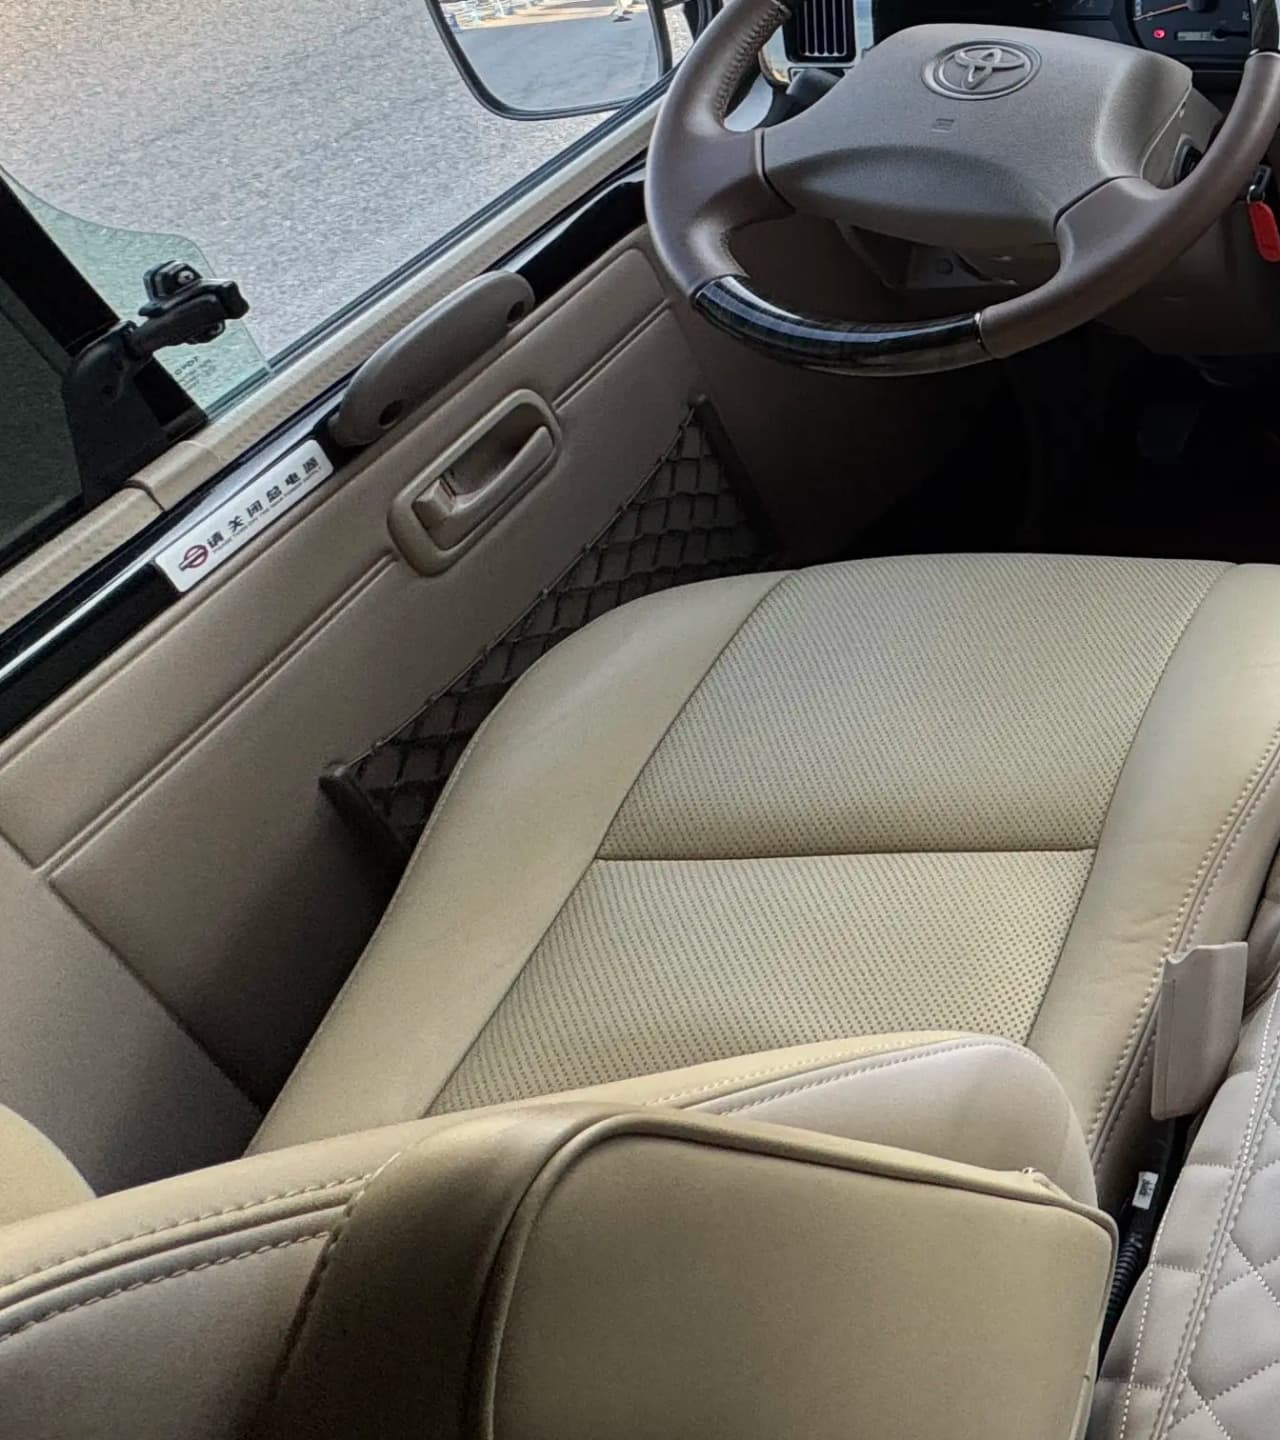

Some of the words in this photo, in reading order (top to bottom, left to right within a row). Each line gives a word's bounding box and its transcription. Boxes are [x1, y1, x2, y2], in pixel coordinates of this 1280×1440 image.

[206, 456, 320, 548] 请关闭总电源
